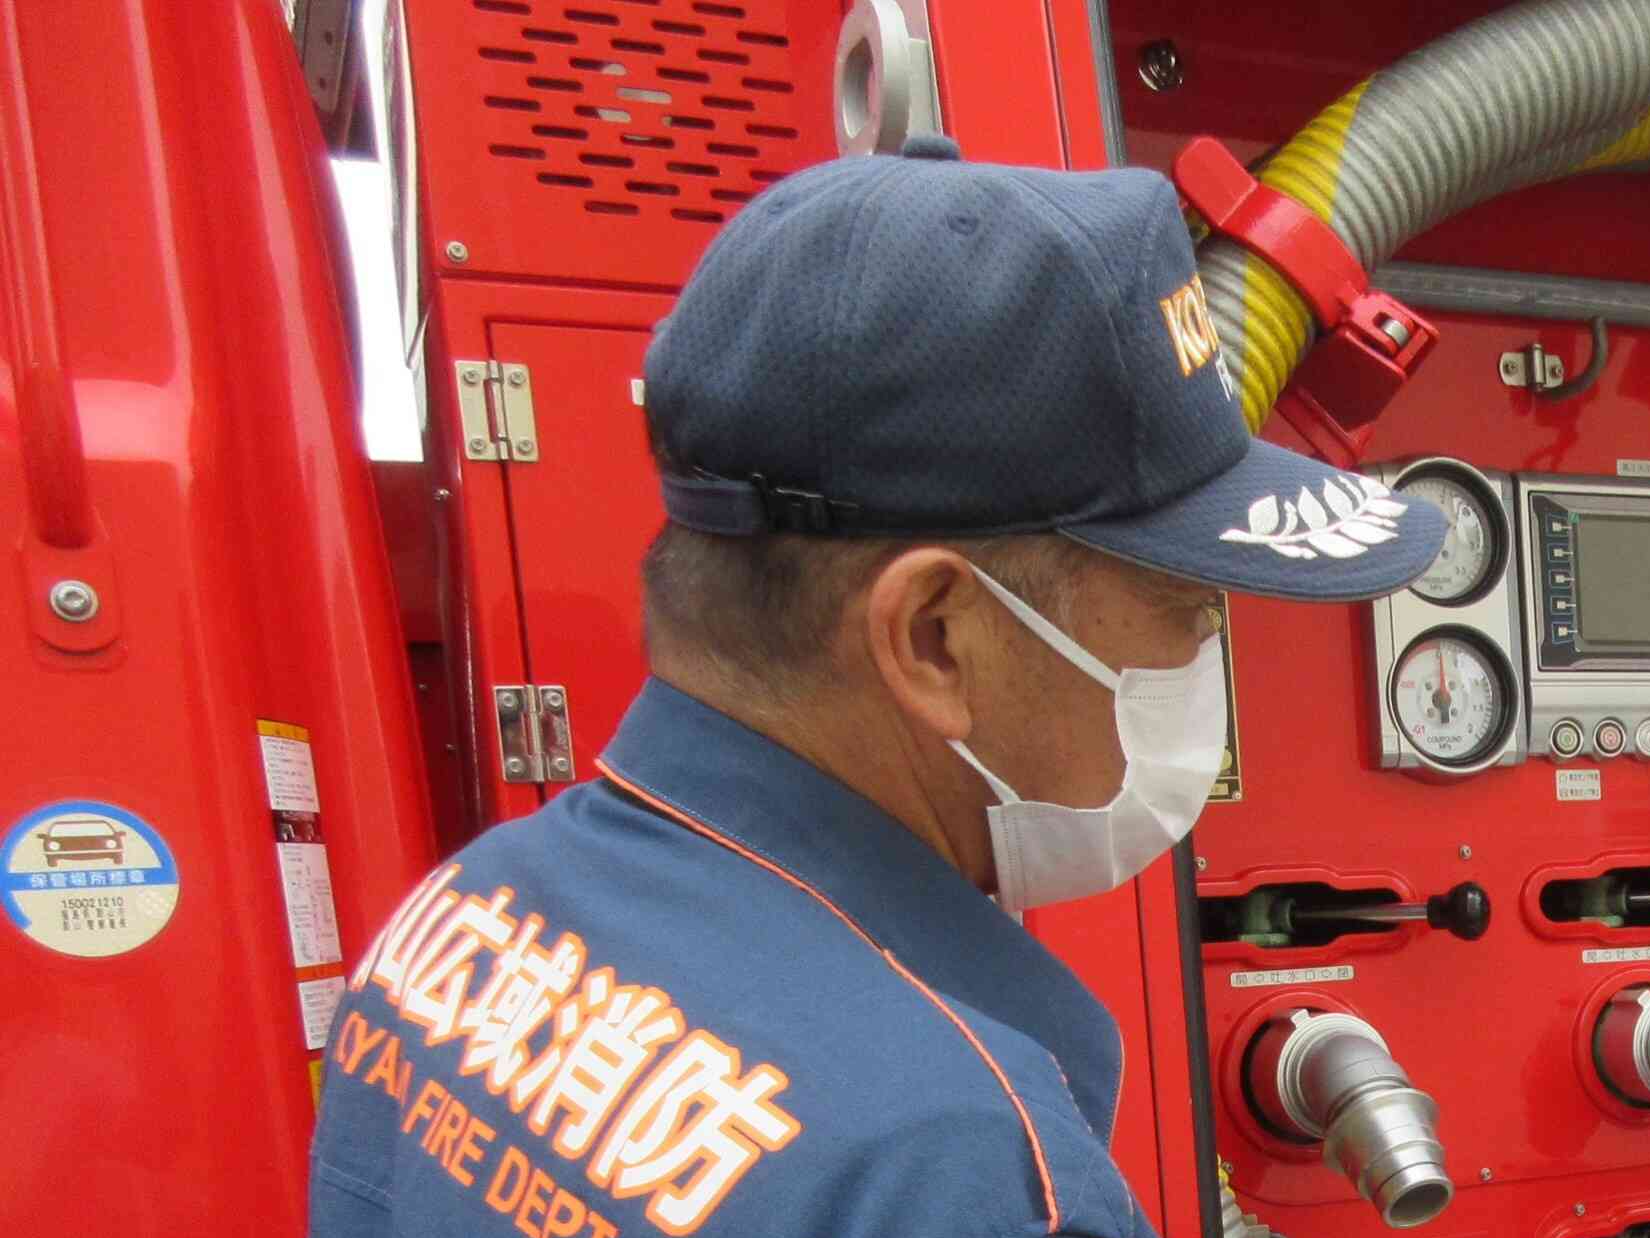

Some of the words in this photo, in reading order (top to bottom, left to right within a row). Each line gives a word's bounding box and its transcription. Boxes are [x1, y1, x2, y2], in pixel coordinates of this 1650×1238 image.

[348, 862, 803, 1237] 山広域消防
[403, 1079, 497, 1188] FIRE
